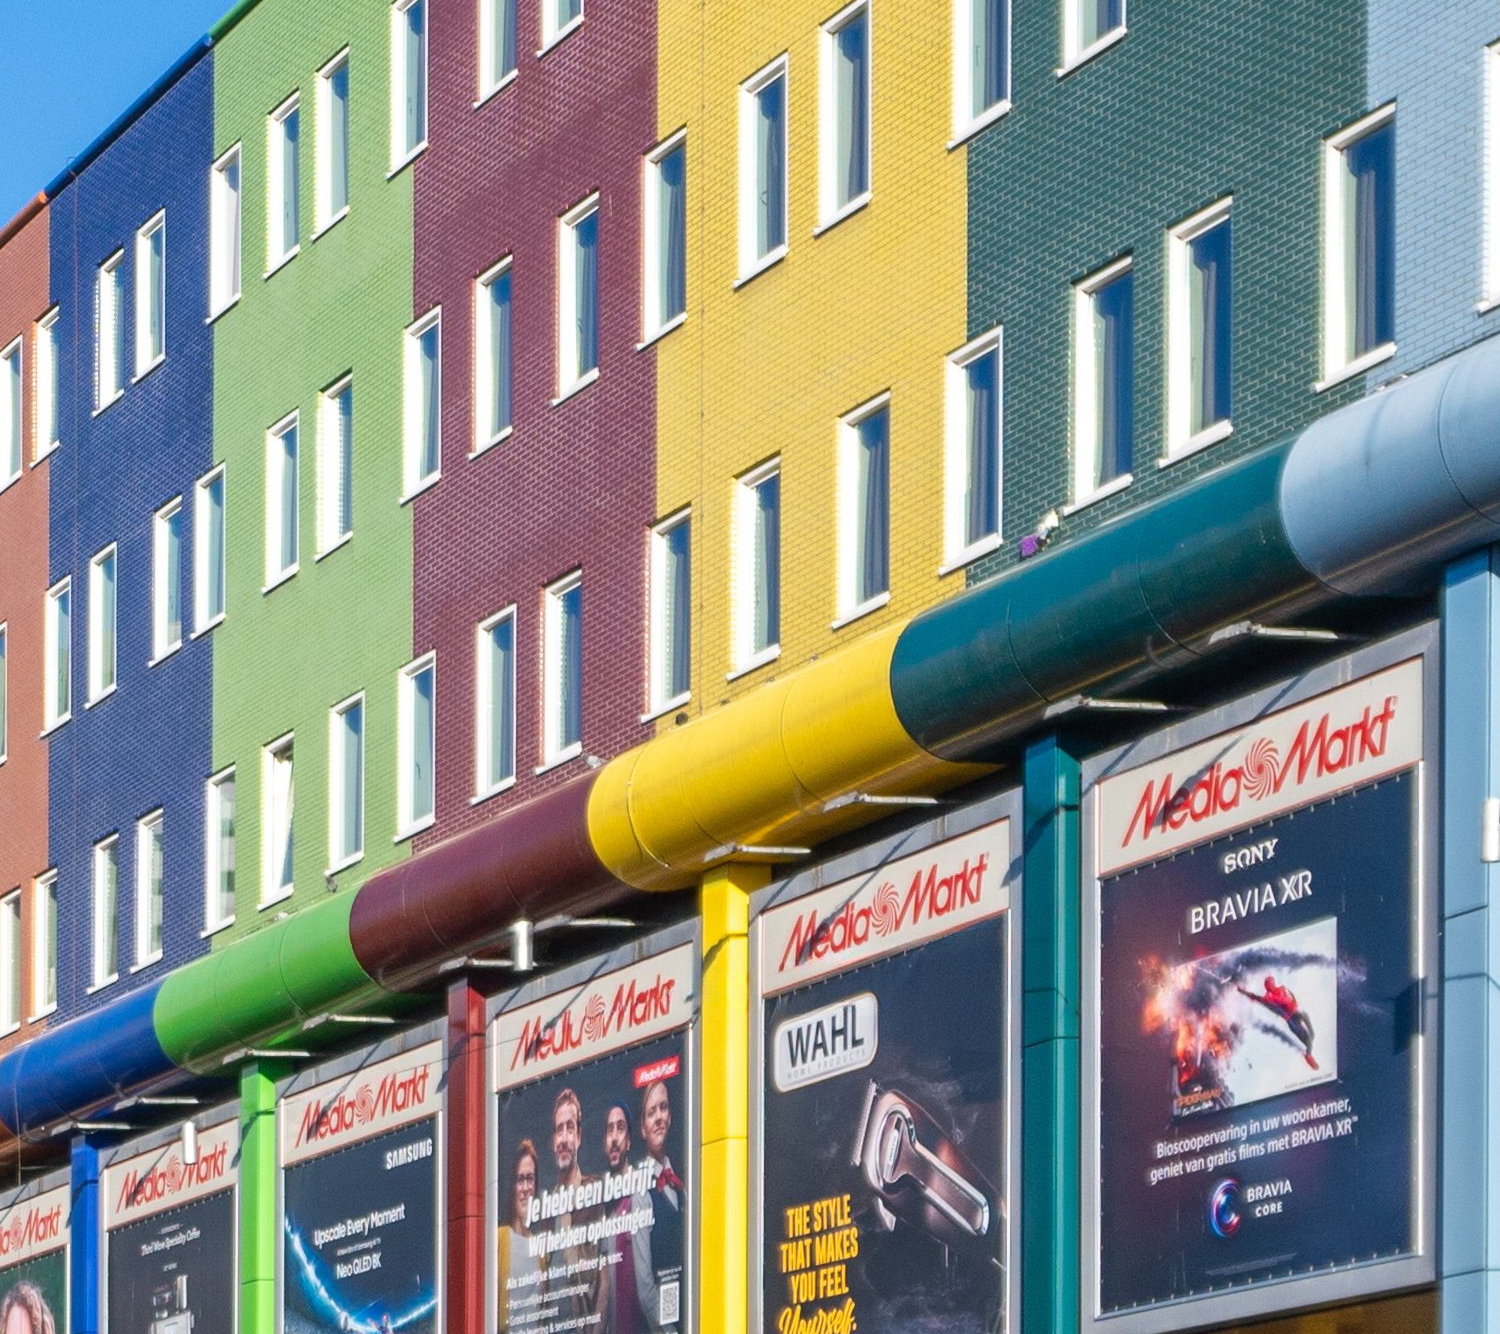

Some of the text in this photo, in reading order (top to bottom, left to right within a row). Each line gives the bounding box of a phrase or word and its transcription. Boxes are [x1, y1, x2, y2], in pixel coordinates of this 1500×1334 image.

[1122, 698, 1395, 848] Media Markt
[1223, 838, 1279, 874] SONY
[778, 856, 988, 972] Media Markt
[1190, 870, 1313, 934] BRAVIA XR
[510, 974, 675, 1071] Media Markt
[787, 1004, 865, 1069] WAHL
[297, 1064, 431, 1149] Media Markt
[1156, 1098, 1353, 1159] Bioscoopervaring in uw woonkamer,
[116, 1141, 228, 1213] Media Markt
[386, 1138, 433, 1170] SAMSUNG
[1150, 1162, 1184, 1186] geniet
[1186, 1158, 1206, 1174] van
[1207, 1149, 1237, 1173] gratis
[1239, 1144, 1266, 1161] films
[1268, 1137, 1290, 1153] met
[1292, 1123, 1334, 1147] BRAVIA
[526, 1160, 657, 1228] Je hebt een bedrijf.
[786, 1194, 852, 1238] THE STYLE
[1246, 1179, 1293, 1203] BRAVIA
[1255, 1201, 1283, 1218] CORE
[20, 1203, 62, 1250] Markt
[314, 1222, 347, 1250] Upscale
[346, 1214, 371, 1237] Every
[370, 1202, 406, 1230] Moment
[780, 1227, 859, 1273] THAT MAKES
[791, 1264, 849, 1305] YOU FEEL
